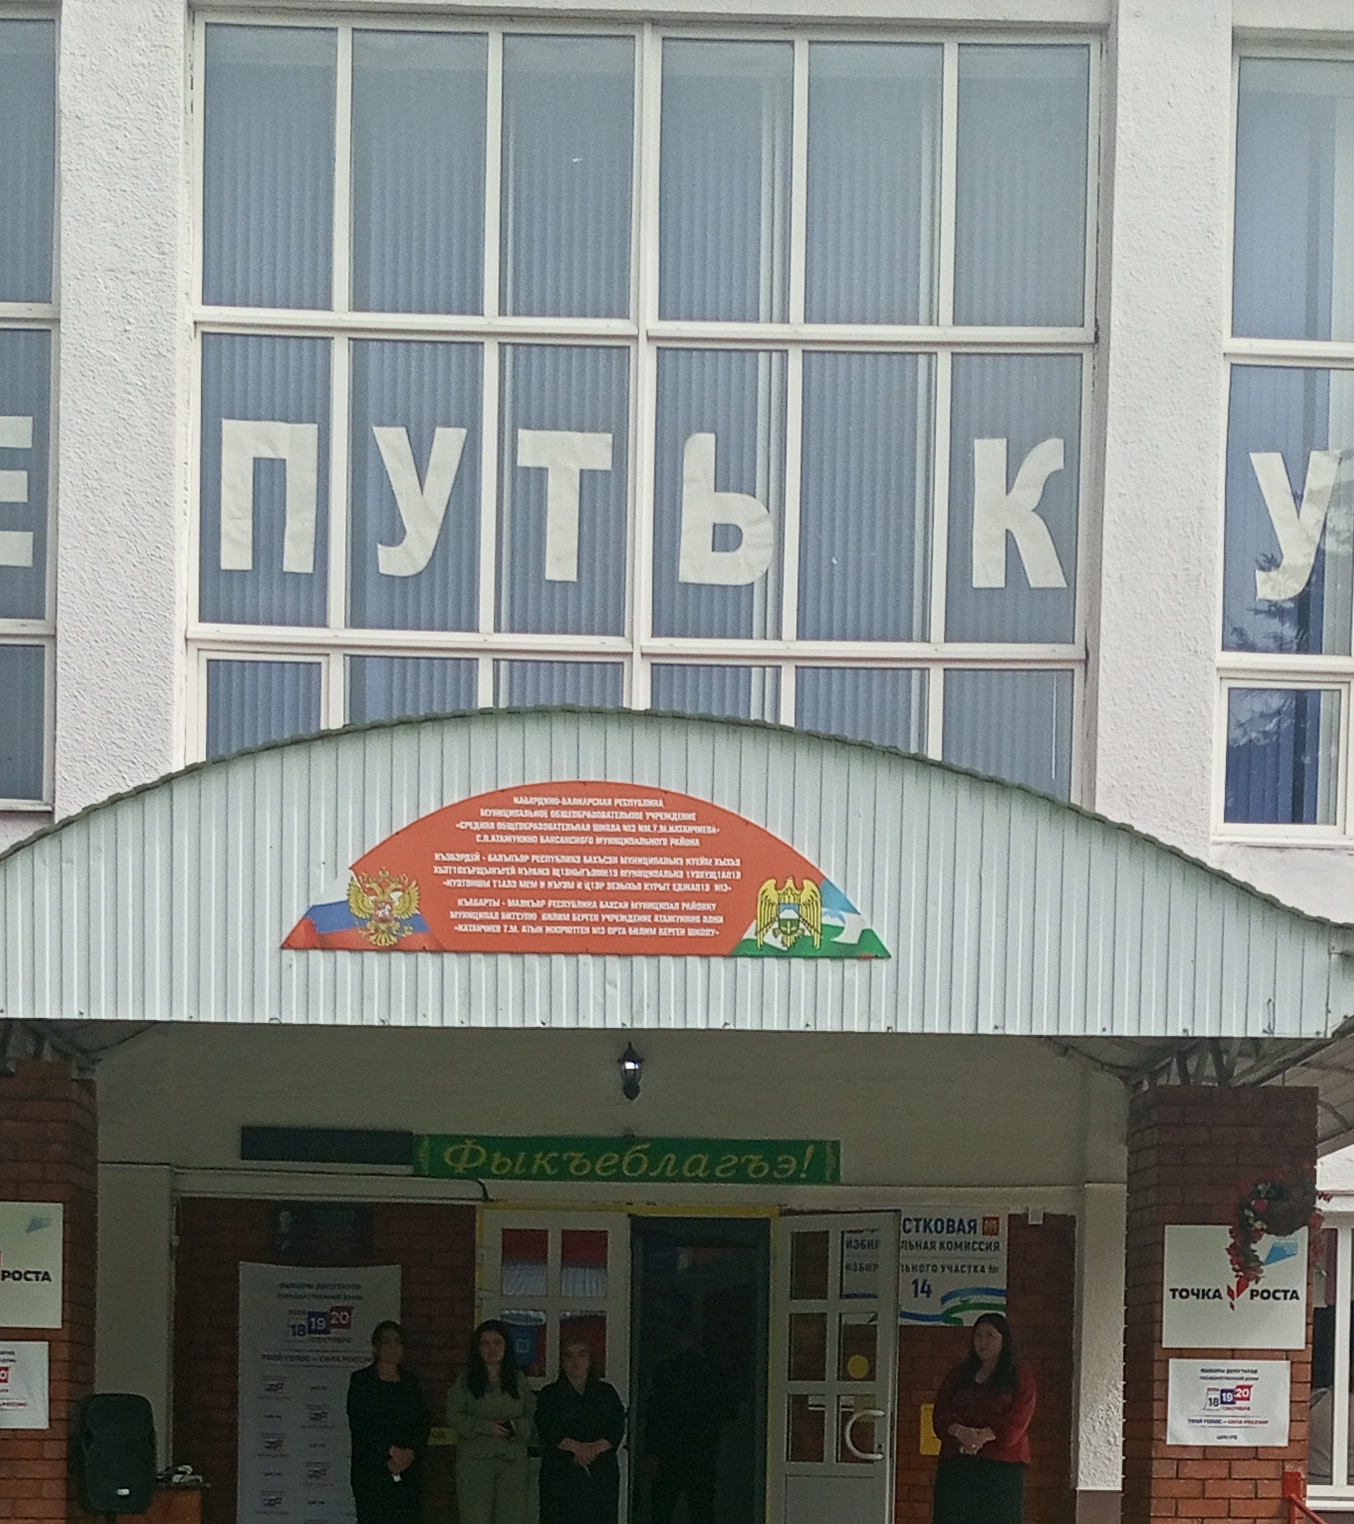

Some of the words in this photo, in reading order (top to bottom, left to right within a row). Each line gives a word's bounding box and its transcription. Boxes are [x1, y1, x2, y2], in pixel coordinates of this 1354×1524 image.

[219, 419, 774, 587] ПУТЬ
[971, 436, 1068, 588] К
[902, 1217, 977, 1235] СТКОВАЯ
[939, 1241, 1000, 1252] КОМИССИЯ
[1, 1270, 52, 1282] РОСТА
[911, 1278, 933, 1298] 14
[1170, 1288, 1223, 1300] ТОЧКА
[1250, 1289, 1300, 1301] РОСТА
[1208, 1397, 1219, 1407] 18
[1222, 1392, 1233, 1402] 19
[1234, 1388, 1250, 1398] 20
